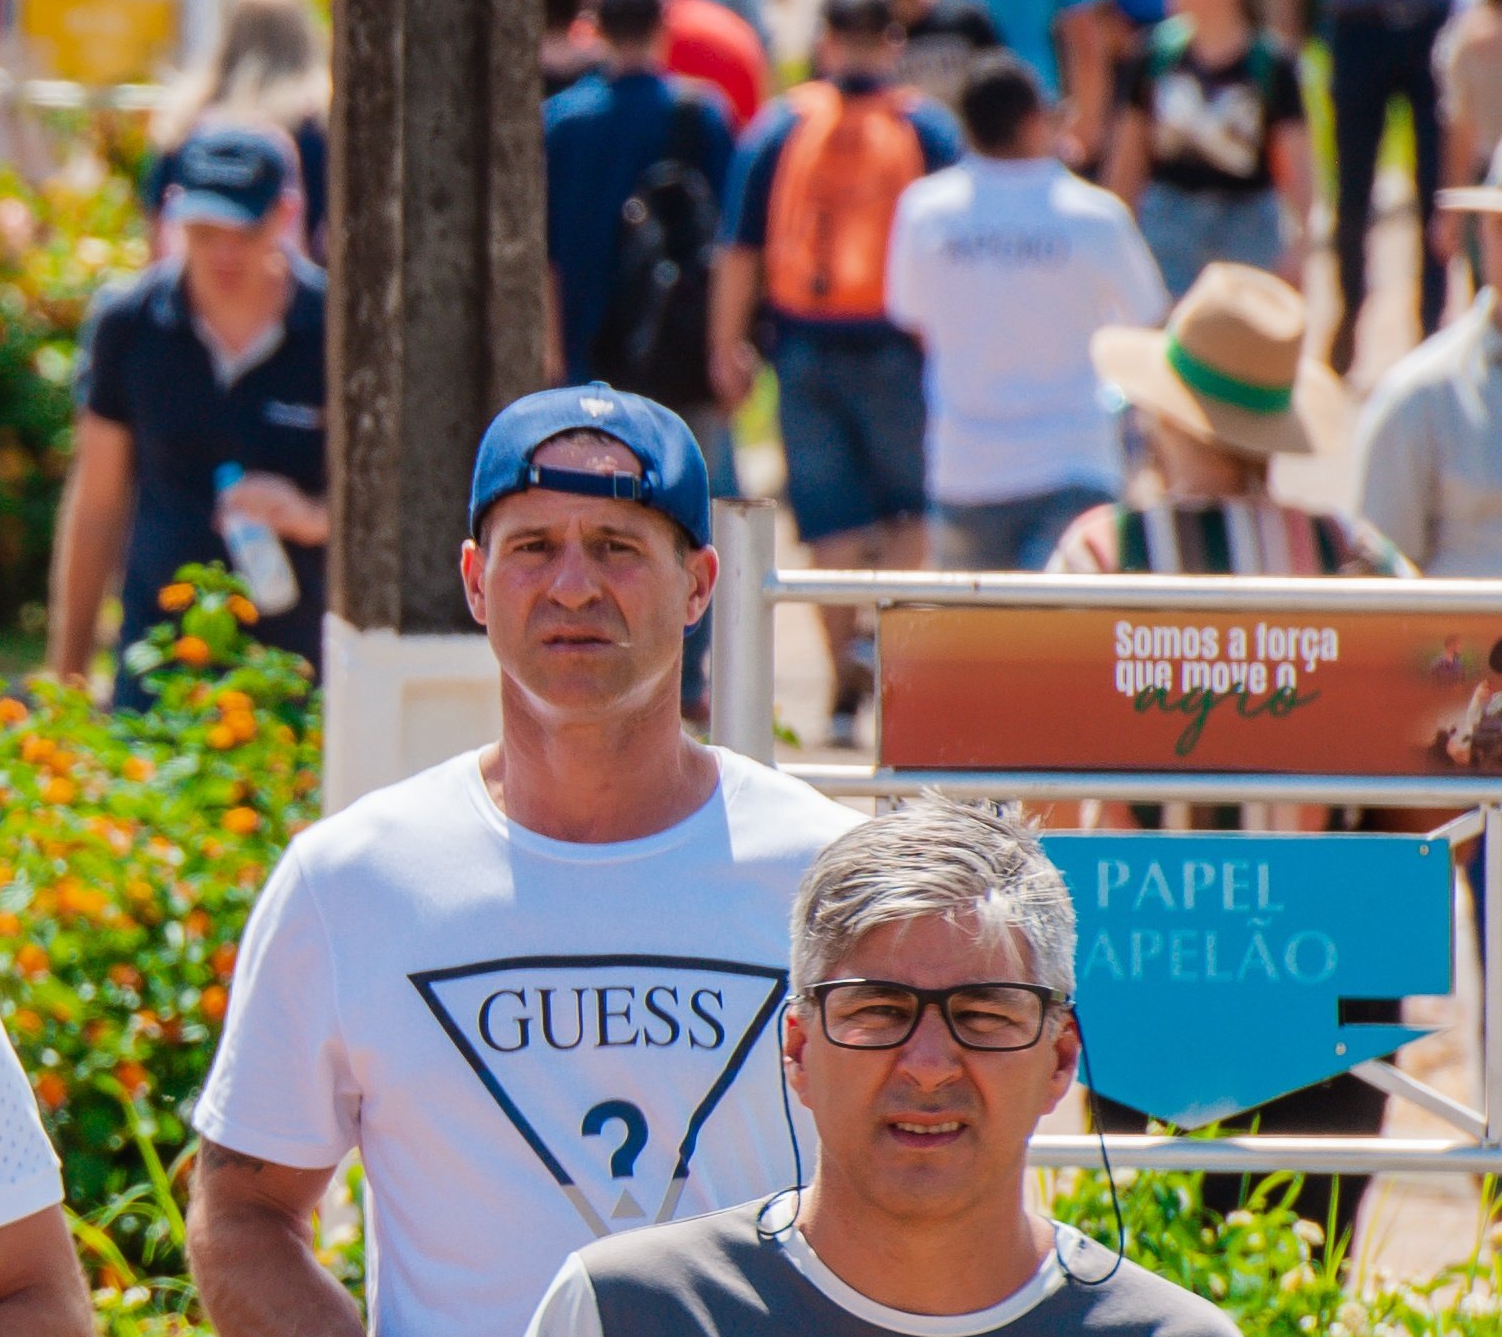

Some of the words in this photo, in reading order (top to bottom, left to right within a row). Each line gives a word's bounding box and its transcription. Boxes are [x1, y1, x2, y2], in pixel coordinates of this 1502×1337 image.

[1115, 620, 1220, 660] Somos
[1228, 626, 1247, 661] a
[1255, 621, 1339, 673] força
[1115, 659, 1173, 697] que
[1182, 660, 1268, 695] move
[1133, 681, 1322, 756] agro
[1096, 859, 1285, 912] PAPEL
[1082, 914, 1341, 986] APELÃO
[478, 985, 725, 1053] GUESS
